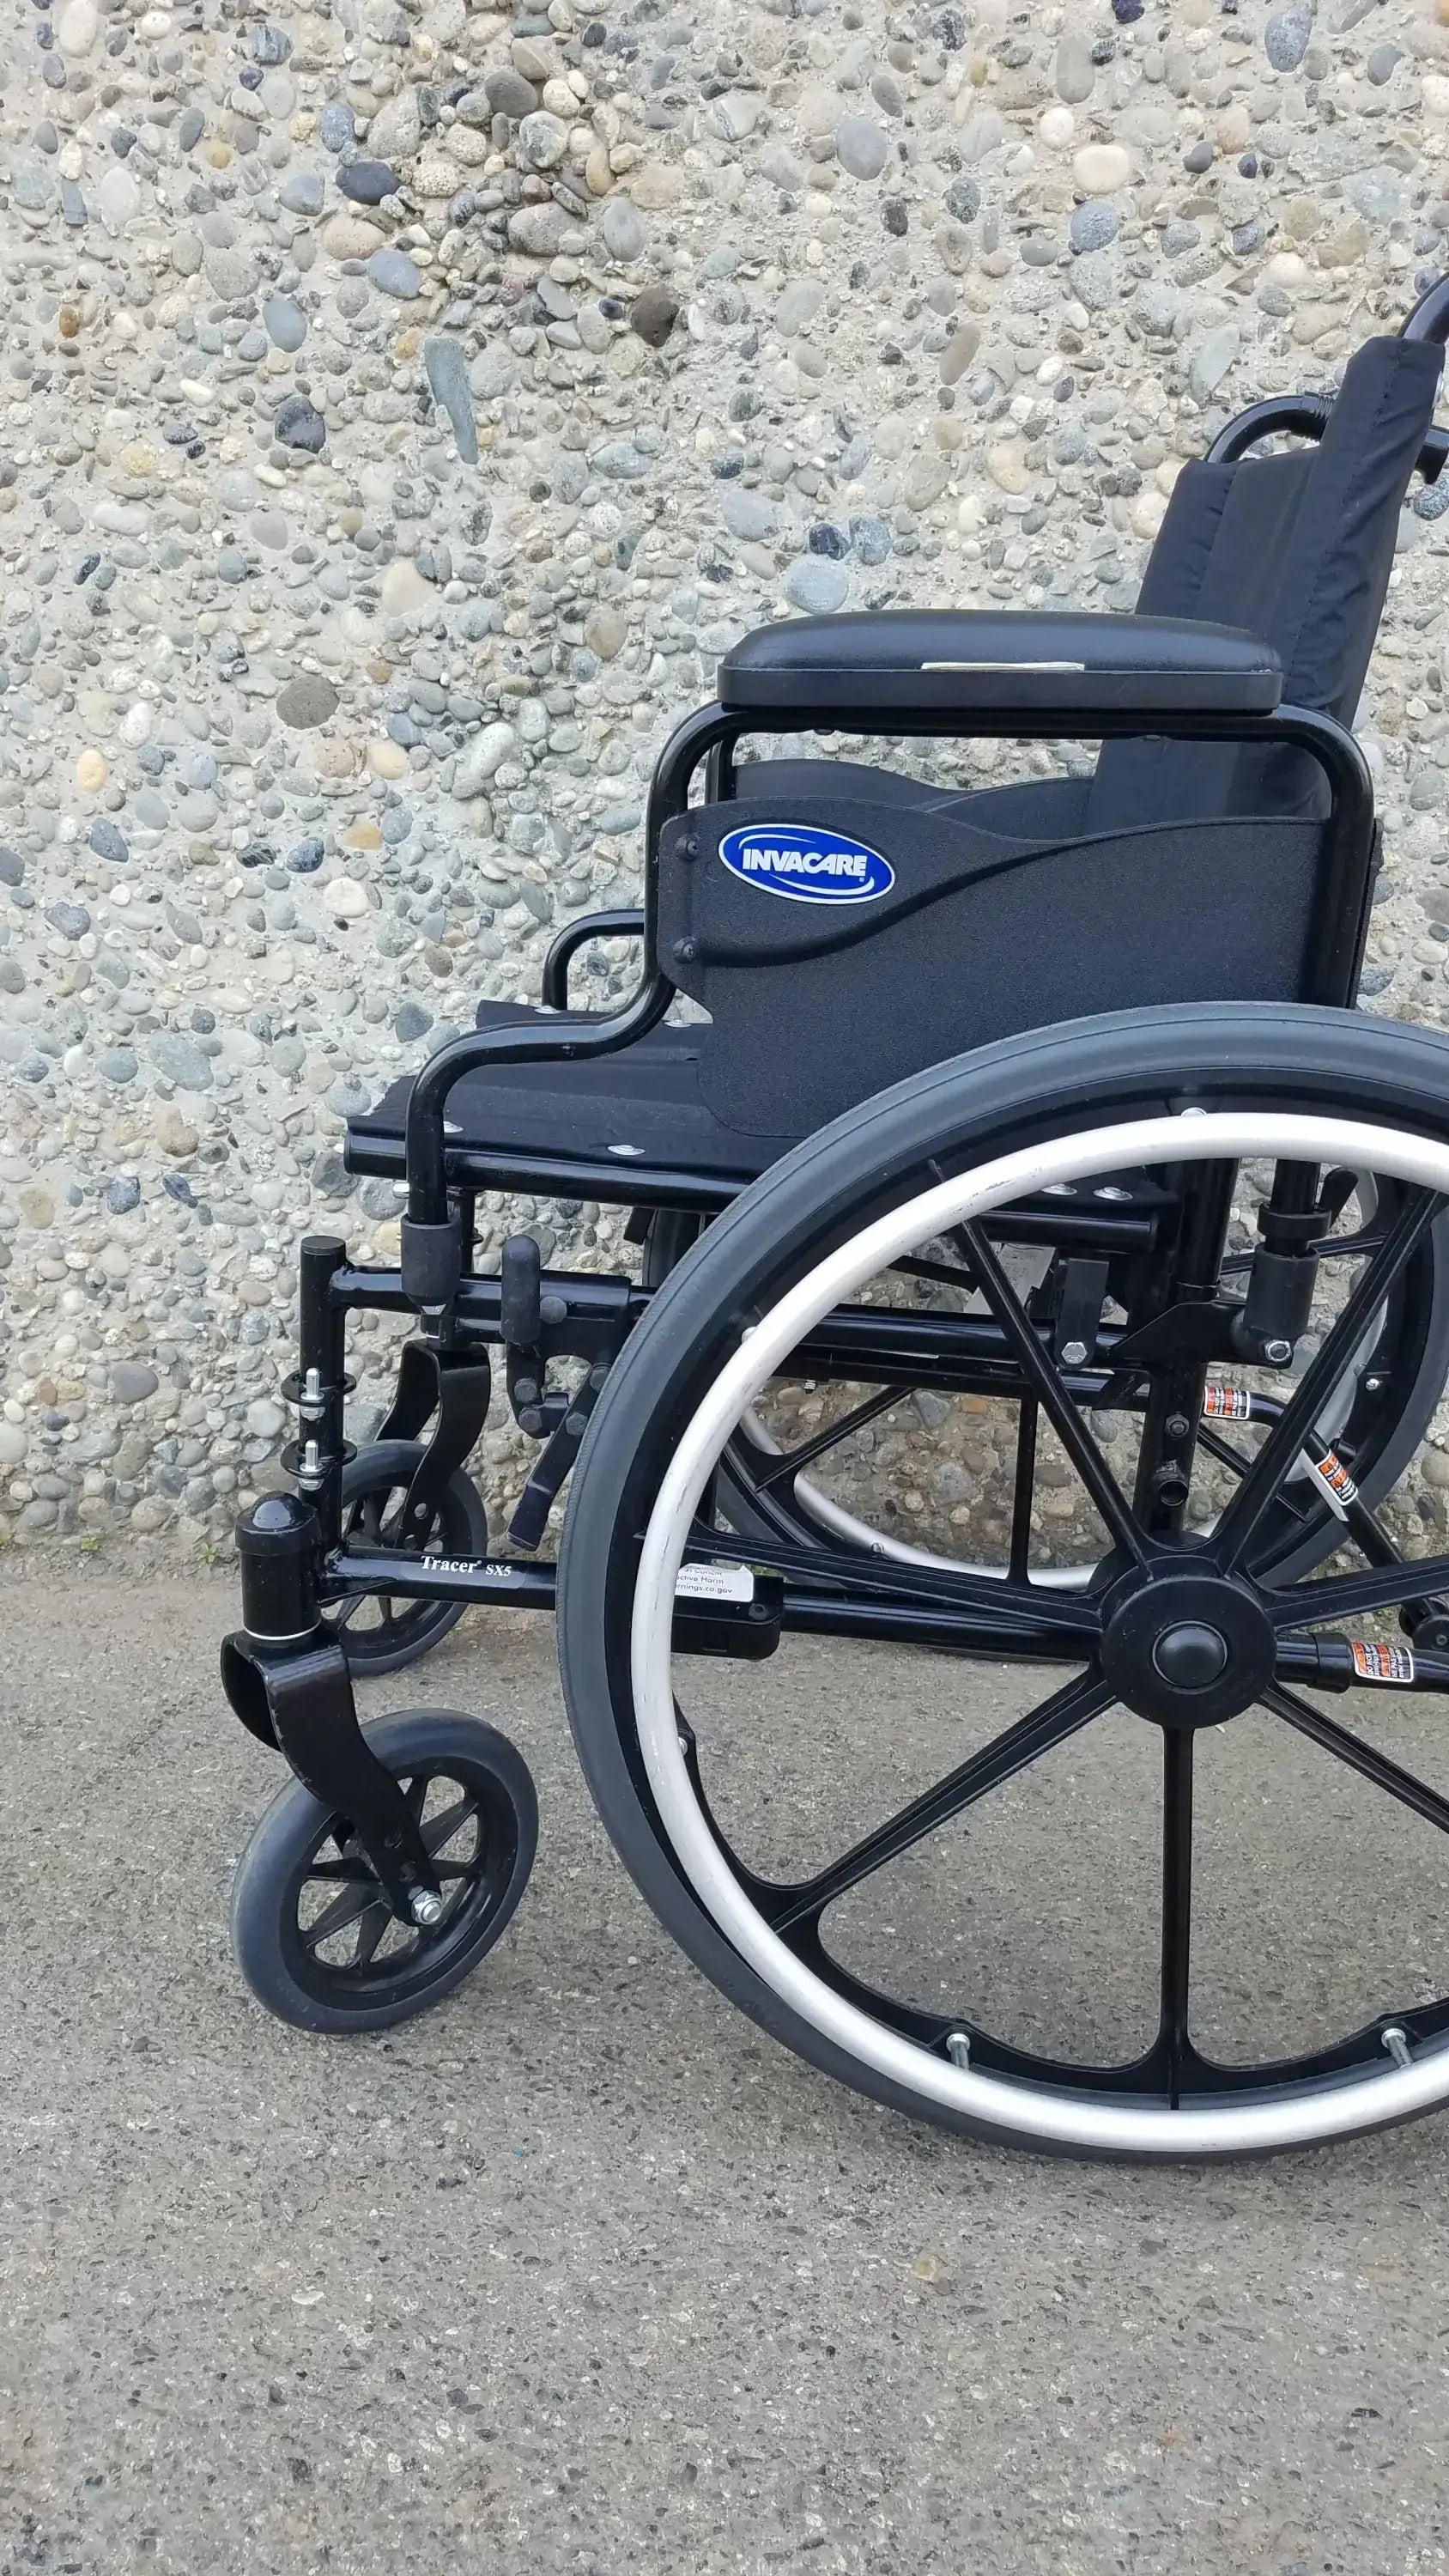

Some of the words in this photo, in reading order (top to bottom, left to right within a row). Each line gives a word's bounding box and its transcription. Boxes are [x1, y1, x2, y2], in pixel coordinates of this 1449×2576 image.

[742, 848, 868, 877] INVACARE
[485, 1564, 512, 1577] SX5
[700, 1577, 724, 1585] Harm
[676, 1583, 733, 1595] rnings.ca.gov
